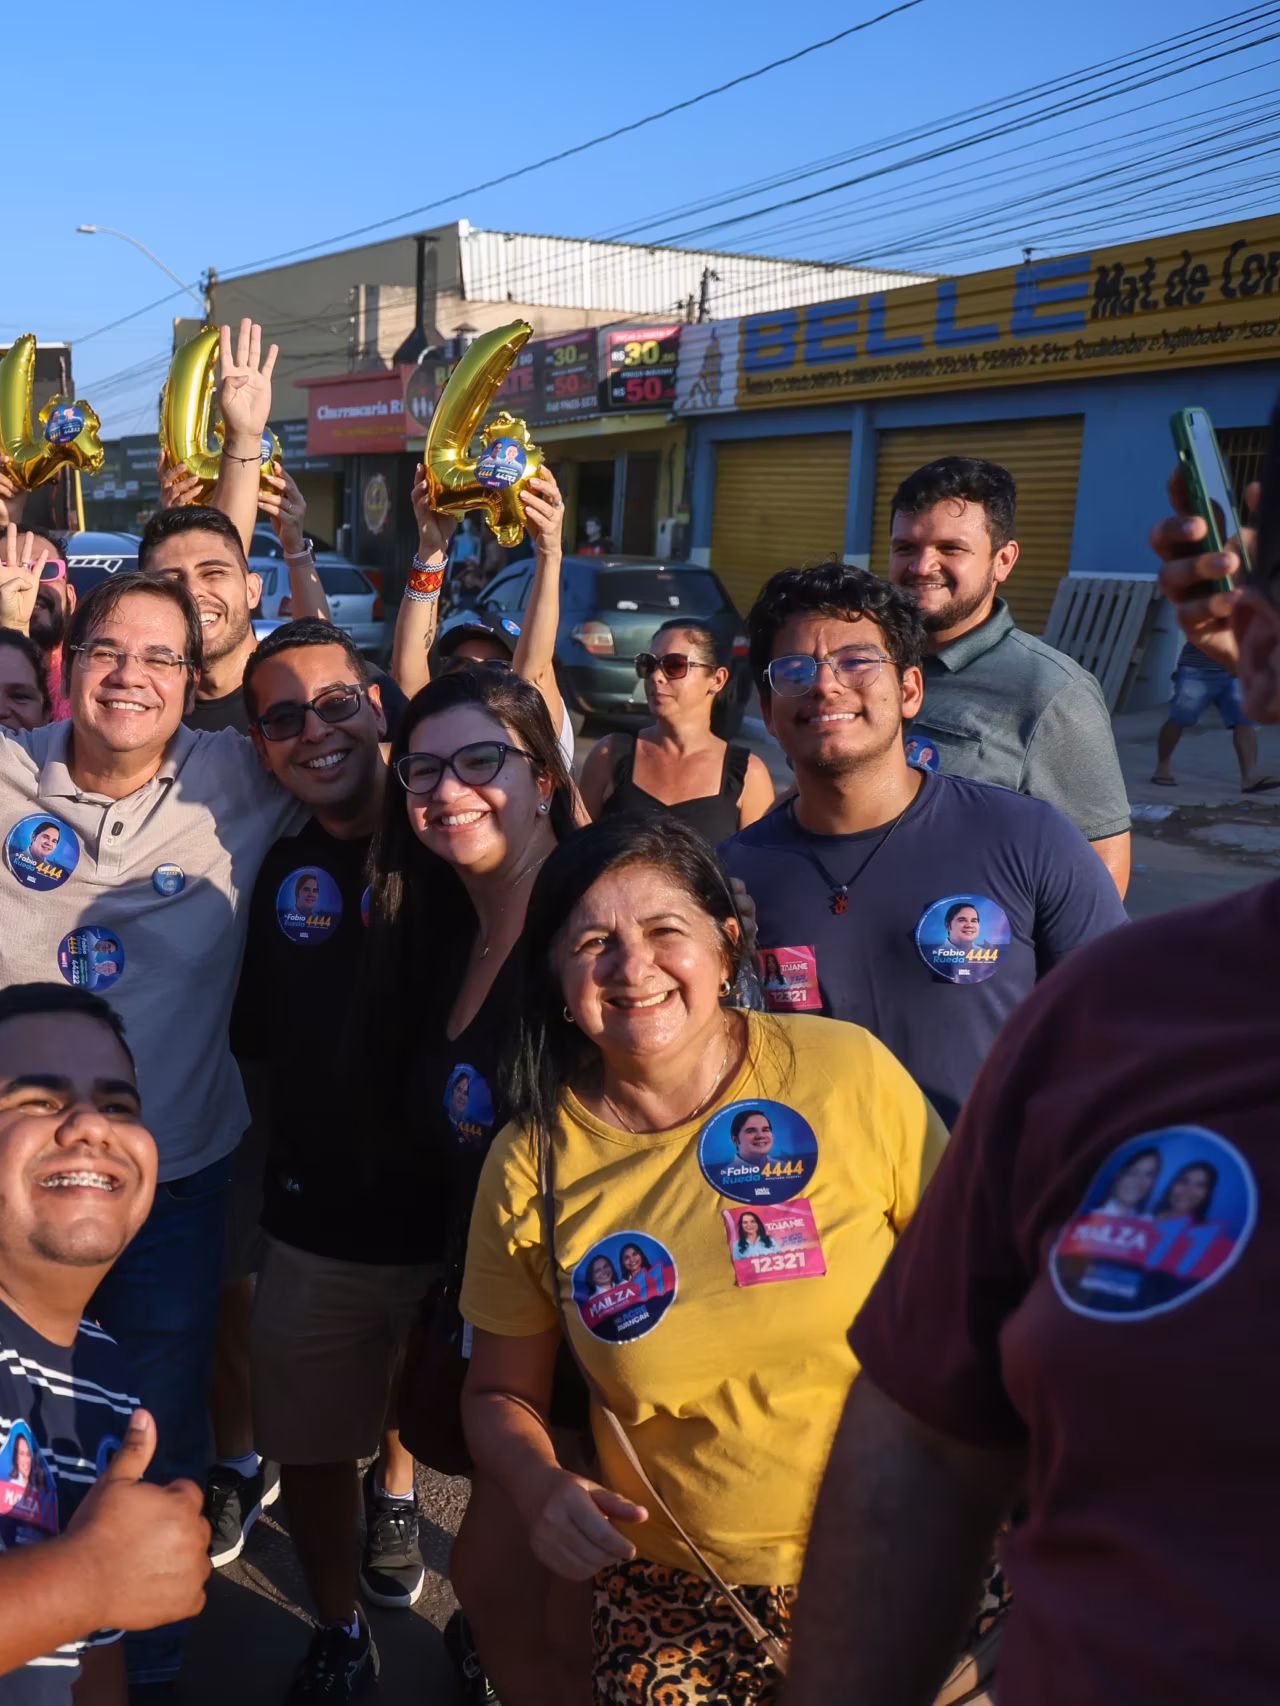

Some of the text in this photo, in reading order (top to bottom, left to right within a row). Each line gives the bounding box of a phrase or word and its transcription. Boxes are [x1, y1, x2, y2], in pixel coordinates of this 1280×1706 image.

[742, 256, 1093, 373] BELLE
[13, 857, 36, 872] Rueda
[19, 853, 37, 865] Fabio
[36, 862, 63, 879] 4444
[287, 913, 306, 921] Fabio
[306, 914, 331, 927] 4444
[933, 955, 965, 964] Rueda
[937, 948, 965, 957] Fabio
[966, 948, 998, 961] 4444
[770, 989, 807, 1003] 12321
[727, 1164, 760, 1177] Fabio
[761, 1160, 805, 1178] 4444
[722, 1173, 761, 1185] Rueda
[1144, 1215, 1220, 1275] 11
[751, 1252, 806, 1274] 12321
[631, 1261, 665, 1301] 11
[589, 1288, 636, 1317] MAILZA
